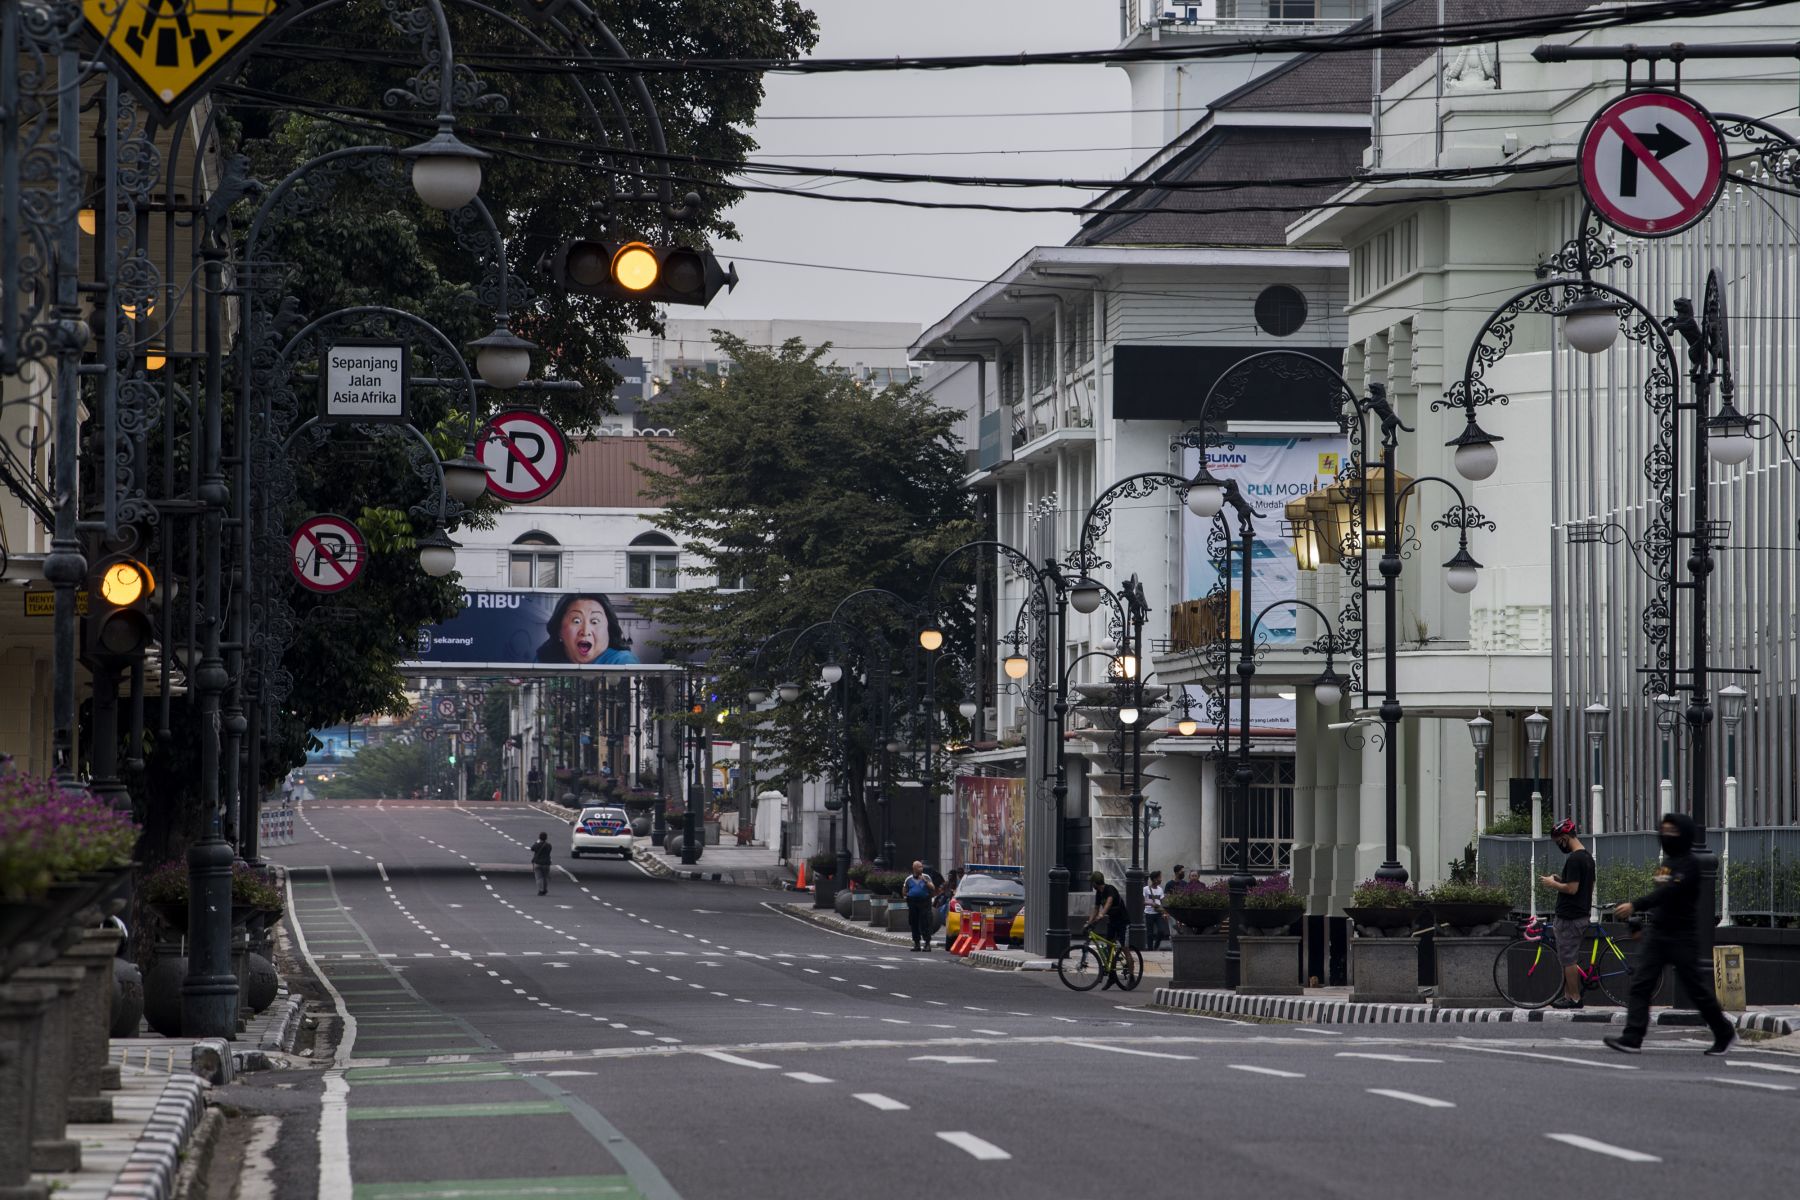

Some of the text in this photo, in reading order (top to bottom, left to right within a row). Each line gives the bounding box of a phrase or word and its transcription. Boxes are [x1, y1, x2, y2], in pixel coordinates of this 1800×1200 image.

[332, 356, 398, 372] Sepanjang
[348, 374, 381, 387] Jalan
[333, 390, 397, 403] Asia Afrika
[1247, 484, 1272, 495] PLN
[1255, 500, 1284, 509] Mudah
[433, 636, 474, 646] sekarang!
